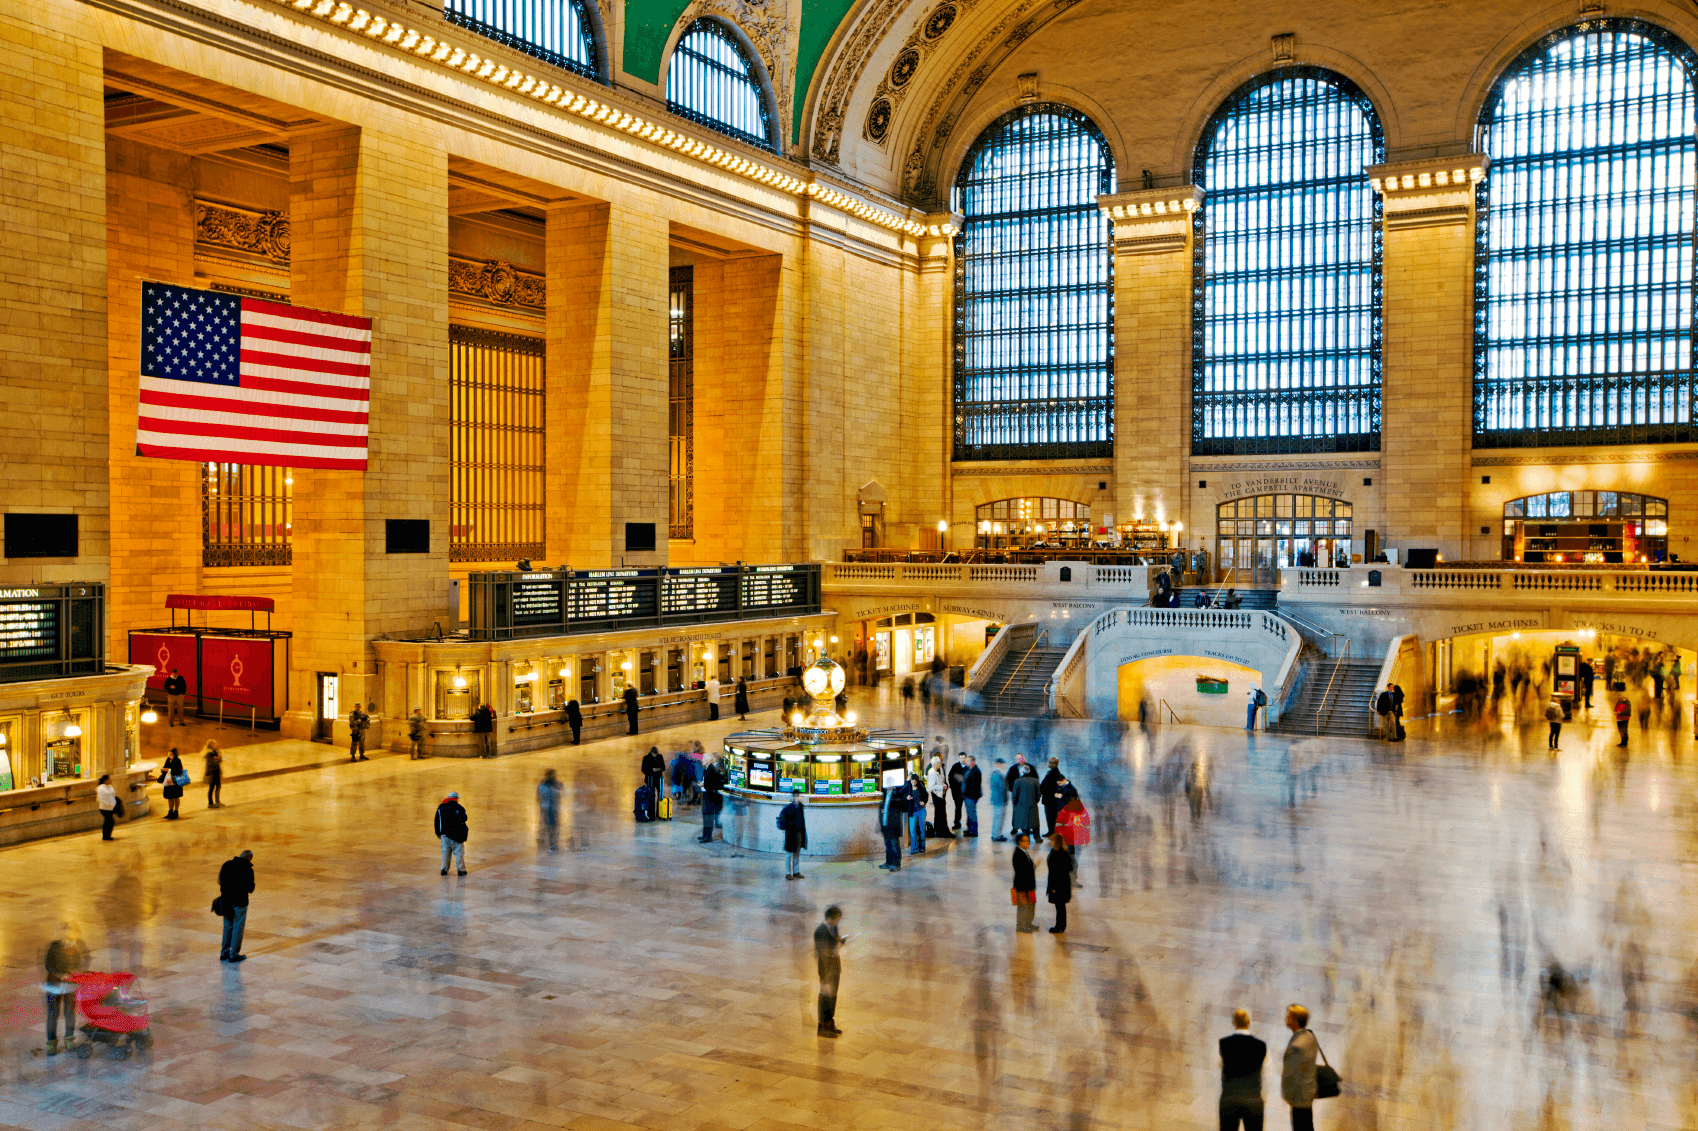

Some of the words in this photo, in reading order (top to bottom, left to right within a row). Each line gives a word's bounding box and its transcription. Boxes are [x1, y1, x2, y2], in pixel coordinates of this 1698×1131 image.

[1230, 482, 1242, 490] TO
[1245, 477, 1299, 487] VANDERBILT
[1303, 478, 1338, 489] AVENUE
[1224, 490, 1241, 499] THE
[1244, 484, 1289, 494] CAMPBELL
[1292, 484, 1345, 498] APARTMENT
[856, 607, 881, 618] TICKET
[882, 603, 920, 612] MACHINES
[942, 604, 972, 614] SUBWAY
[976, 609, 995, 618] 42ND
[1451, 622, 1484, 634] TICKET
[1488, 619, 1539, 629] MACHINES
[1573, 620, 1615, 631] TRACKS
[1616, 625, 1626, 633] 31
[1629, 626, 1644, 636] TO
[1645, 630, 1657, 639] 42
[1120, 653, 1141, 663] DINING
[1141, 648, 1173, 657] CONCOURSE
[1204, 649, 1225, 658] TRACKS
[65, 690, 86, 698] TOURS
[799, 727, 829, 735] Information
